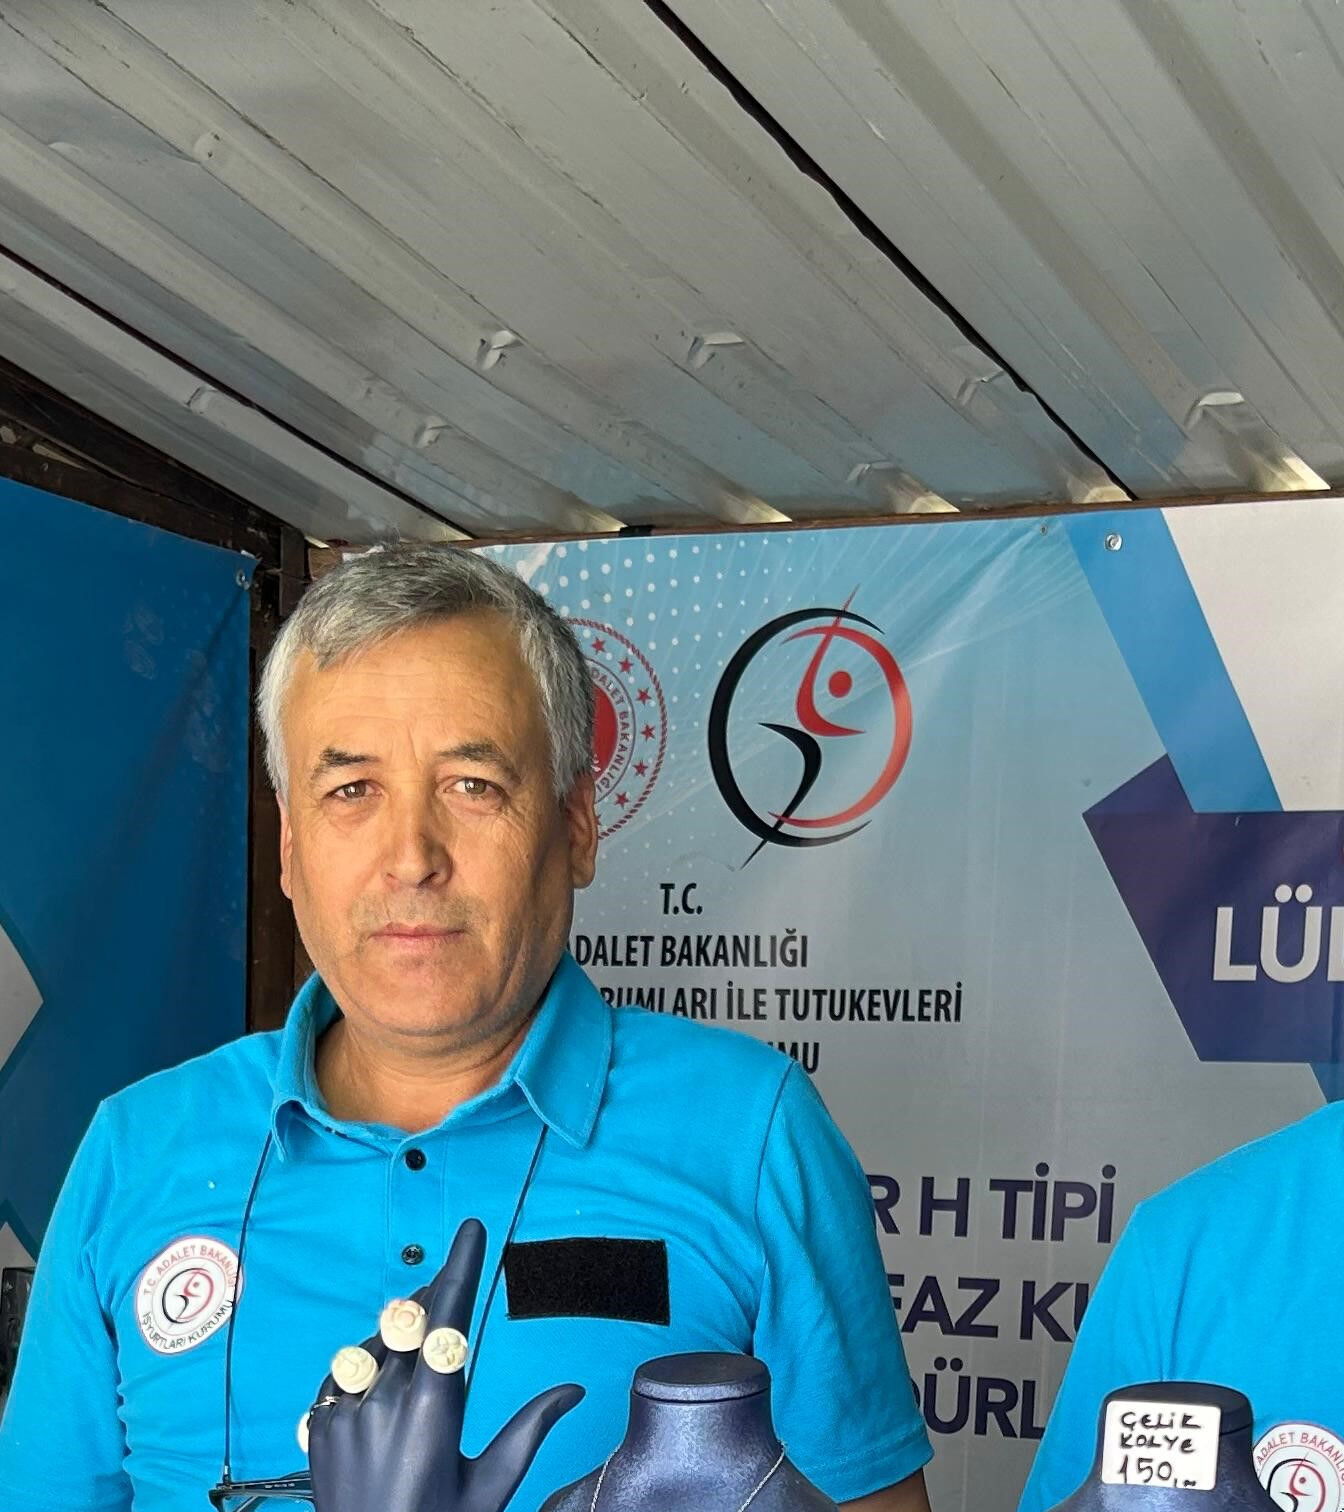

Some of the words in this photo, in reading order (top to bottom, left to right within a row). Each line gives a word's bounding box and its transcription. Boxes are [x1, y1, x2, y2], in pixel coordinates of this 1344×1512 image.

[591, 667, 624, 705] DALET
[660, 883, 703, 915] T.C.
[567, 935, 655, 967] DALET
[660, 928, 808, 967] BAKANLIĞI
[727, 981, 768, 1020] İLE
[775, 981, 963, 1023] TUTUKEVLERİ
[918, 1176, 971, 1238] H
[989, 1162, 1117, 1244] TİPİ
[157, 1245, 196, 1275] ADALET
[189, 1299, 234, 1344] KURUMU
[1120, 1411, 1202, 1431] ÇELİK
[1256, 1432, 1296, 1466] ADALET
